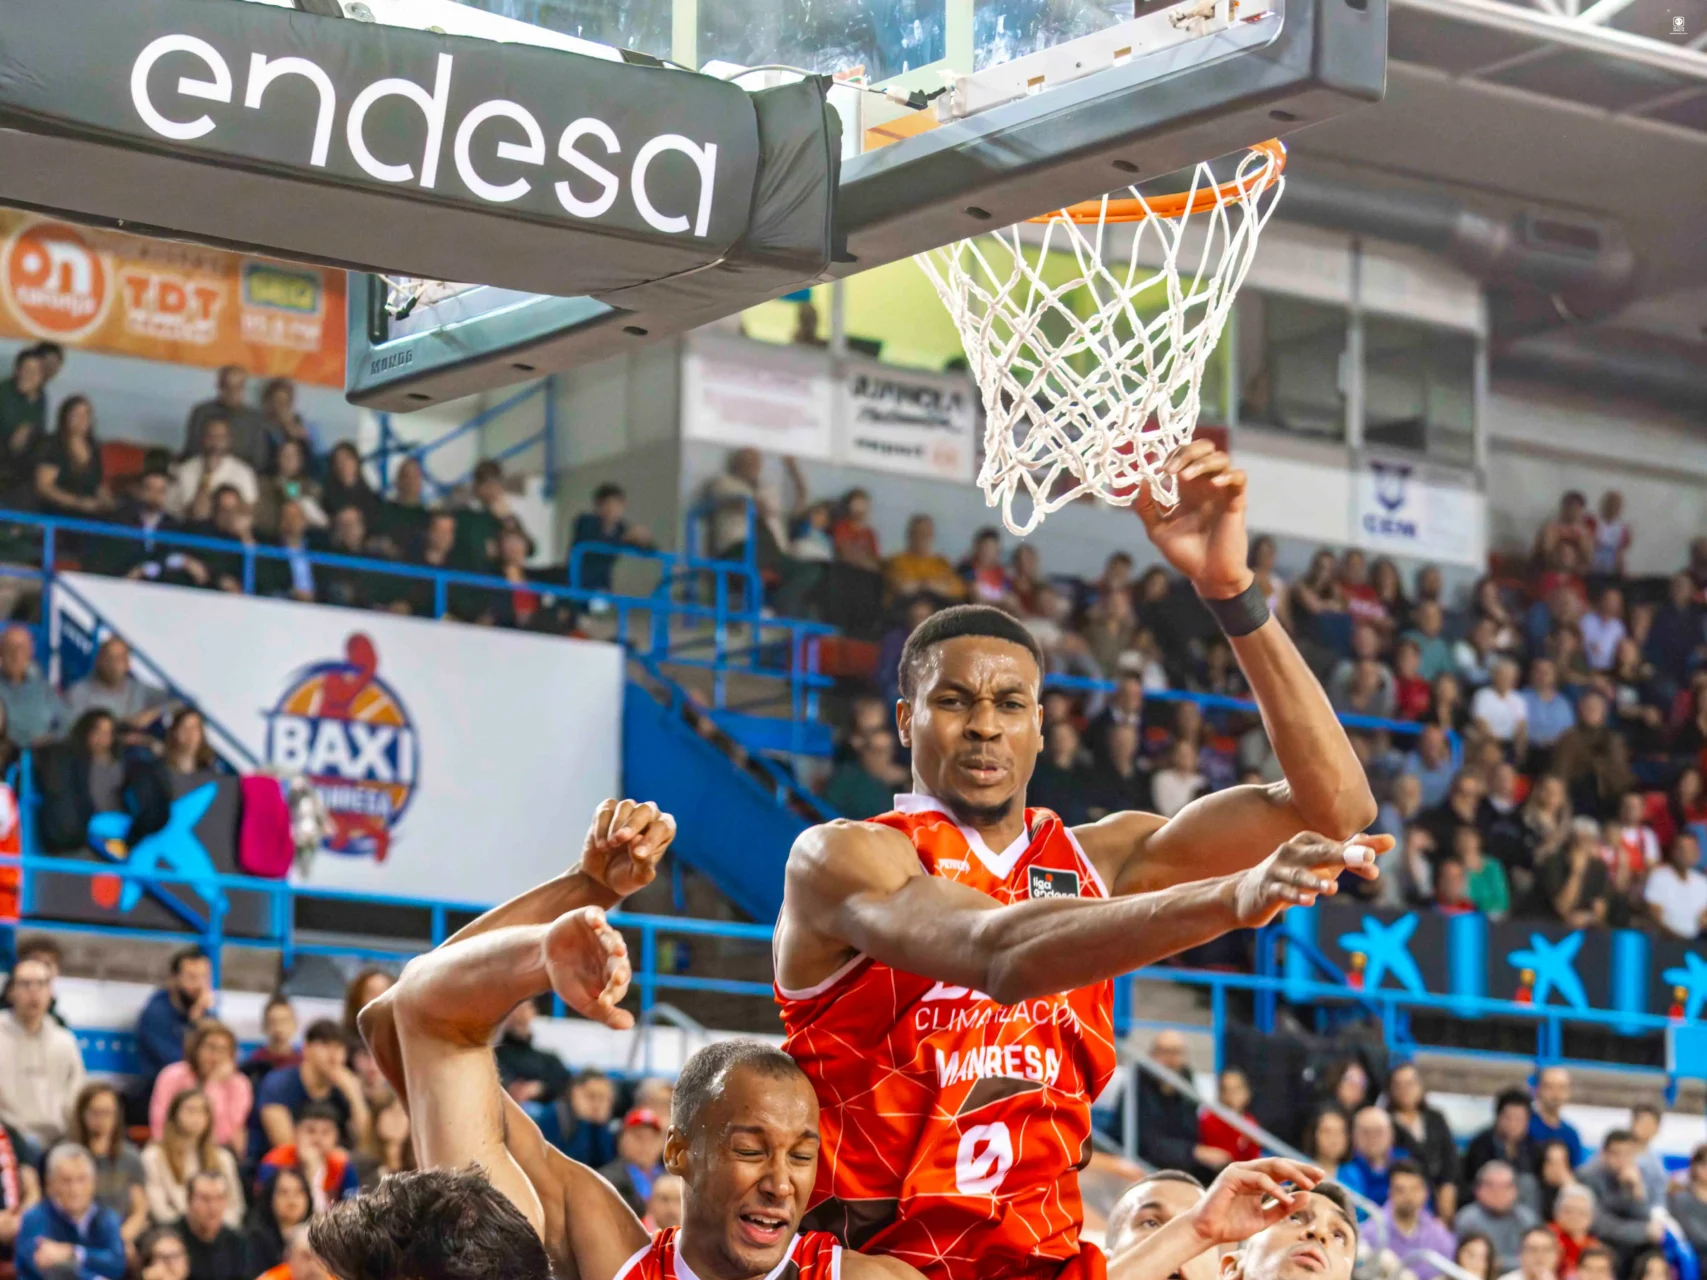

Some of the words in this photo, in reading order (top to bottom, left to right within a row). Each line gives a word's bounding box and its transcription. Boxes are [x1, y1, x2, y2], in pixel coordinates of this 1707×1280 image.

[130, 33, 718, 238] endesa
[272, 715, 414, 784] BAXI
[1032, 876, 1052, 890] liga
[935, 1044, 1060, 1089] MANRESA
[955, 1121, 1013, 1195] 0
